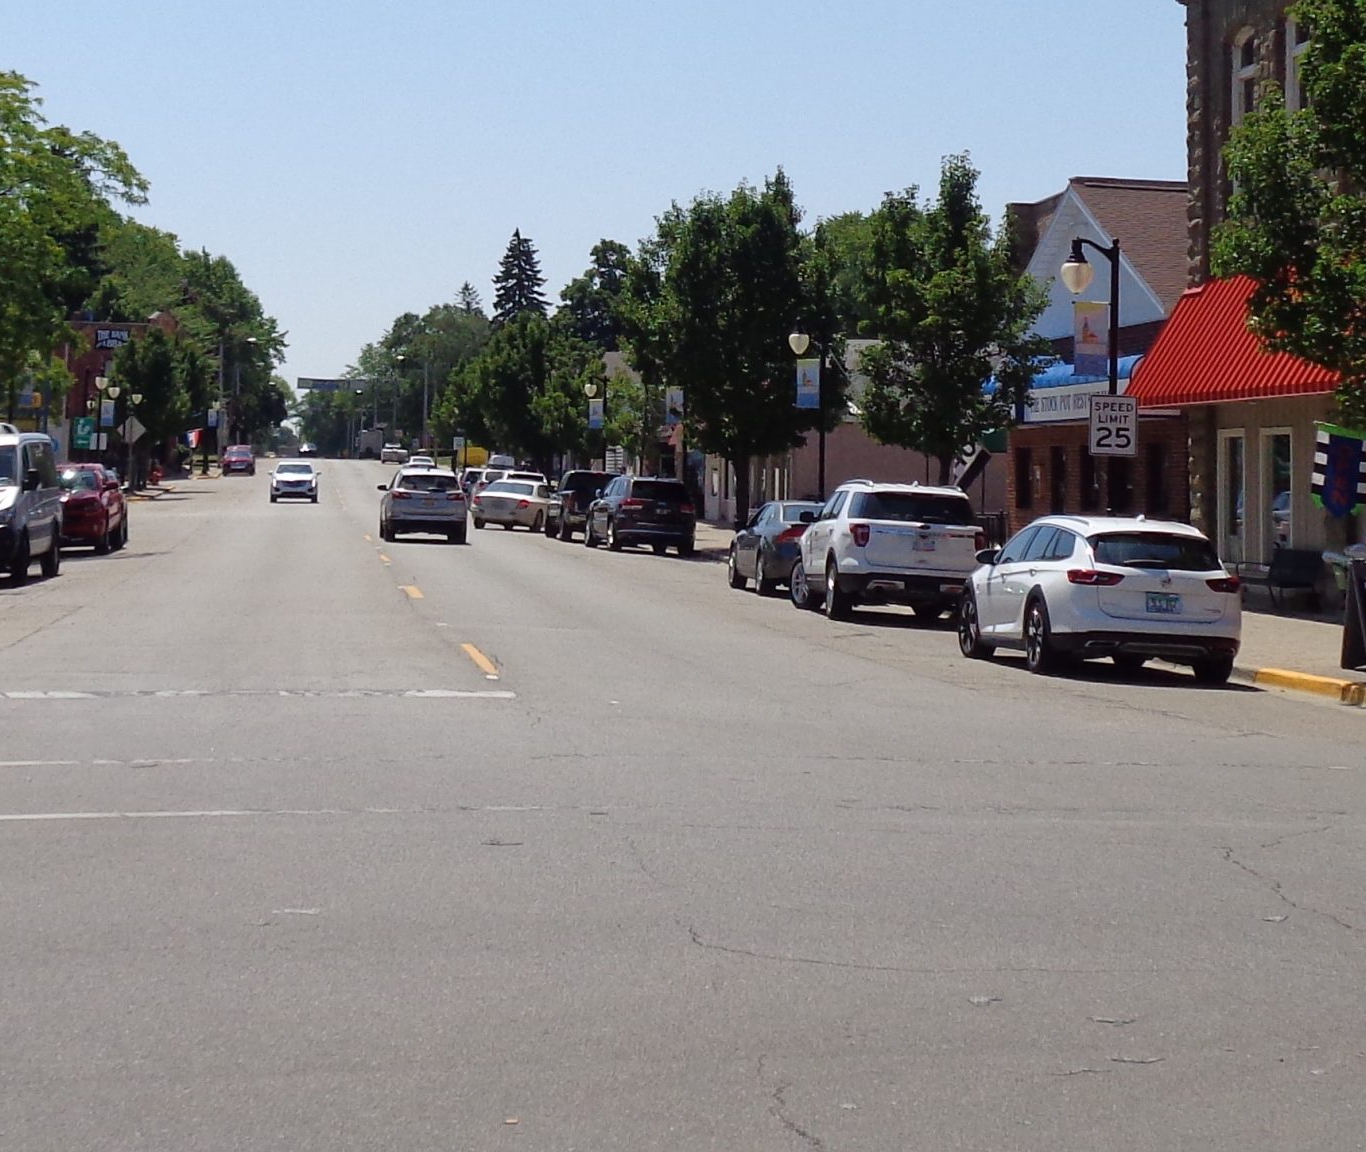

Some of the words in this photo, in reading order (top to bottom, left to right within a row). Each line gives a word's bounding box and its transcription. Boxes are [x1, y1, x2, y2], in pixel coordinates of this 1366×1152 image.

[1094, 402, 1134, 413] SPEED
[1098, 415, 1130, 424] LIMIT
[1095, 427, 1132, 449] 25
